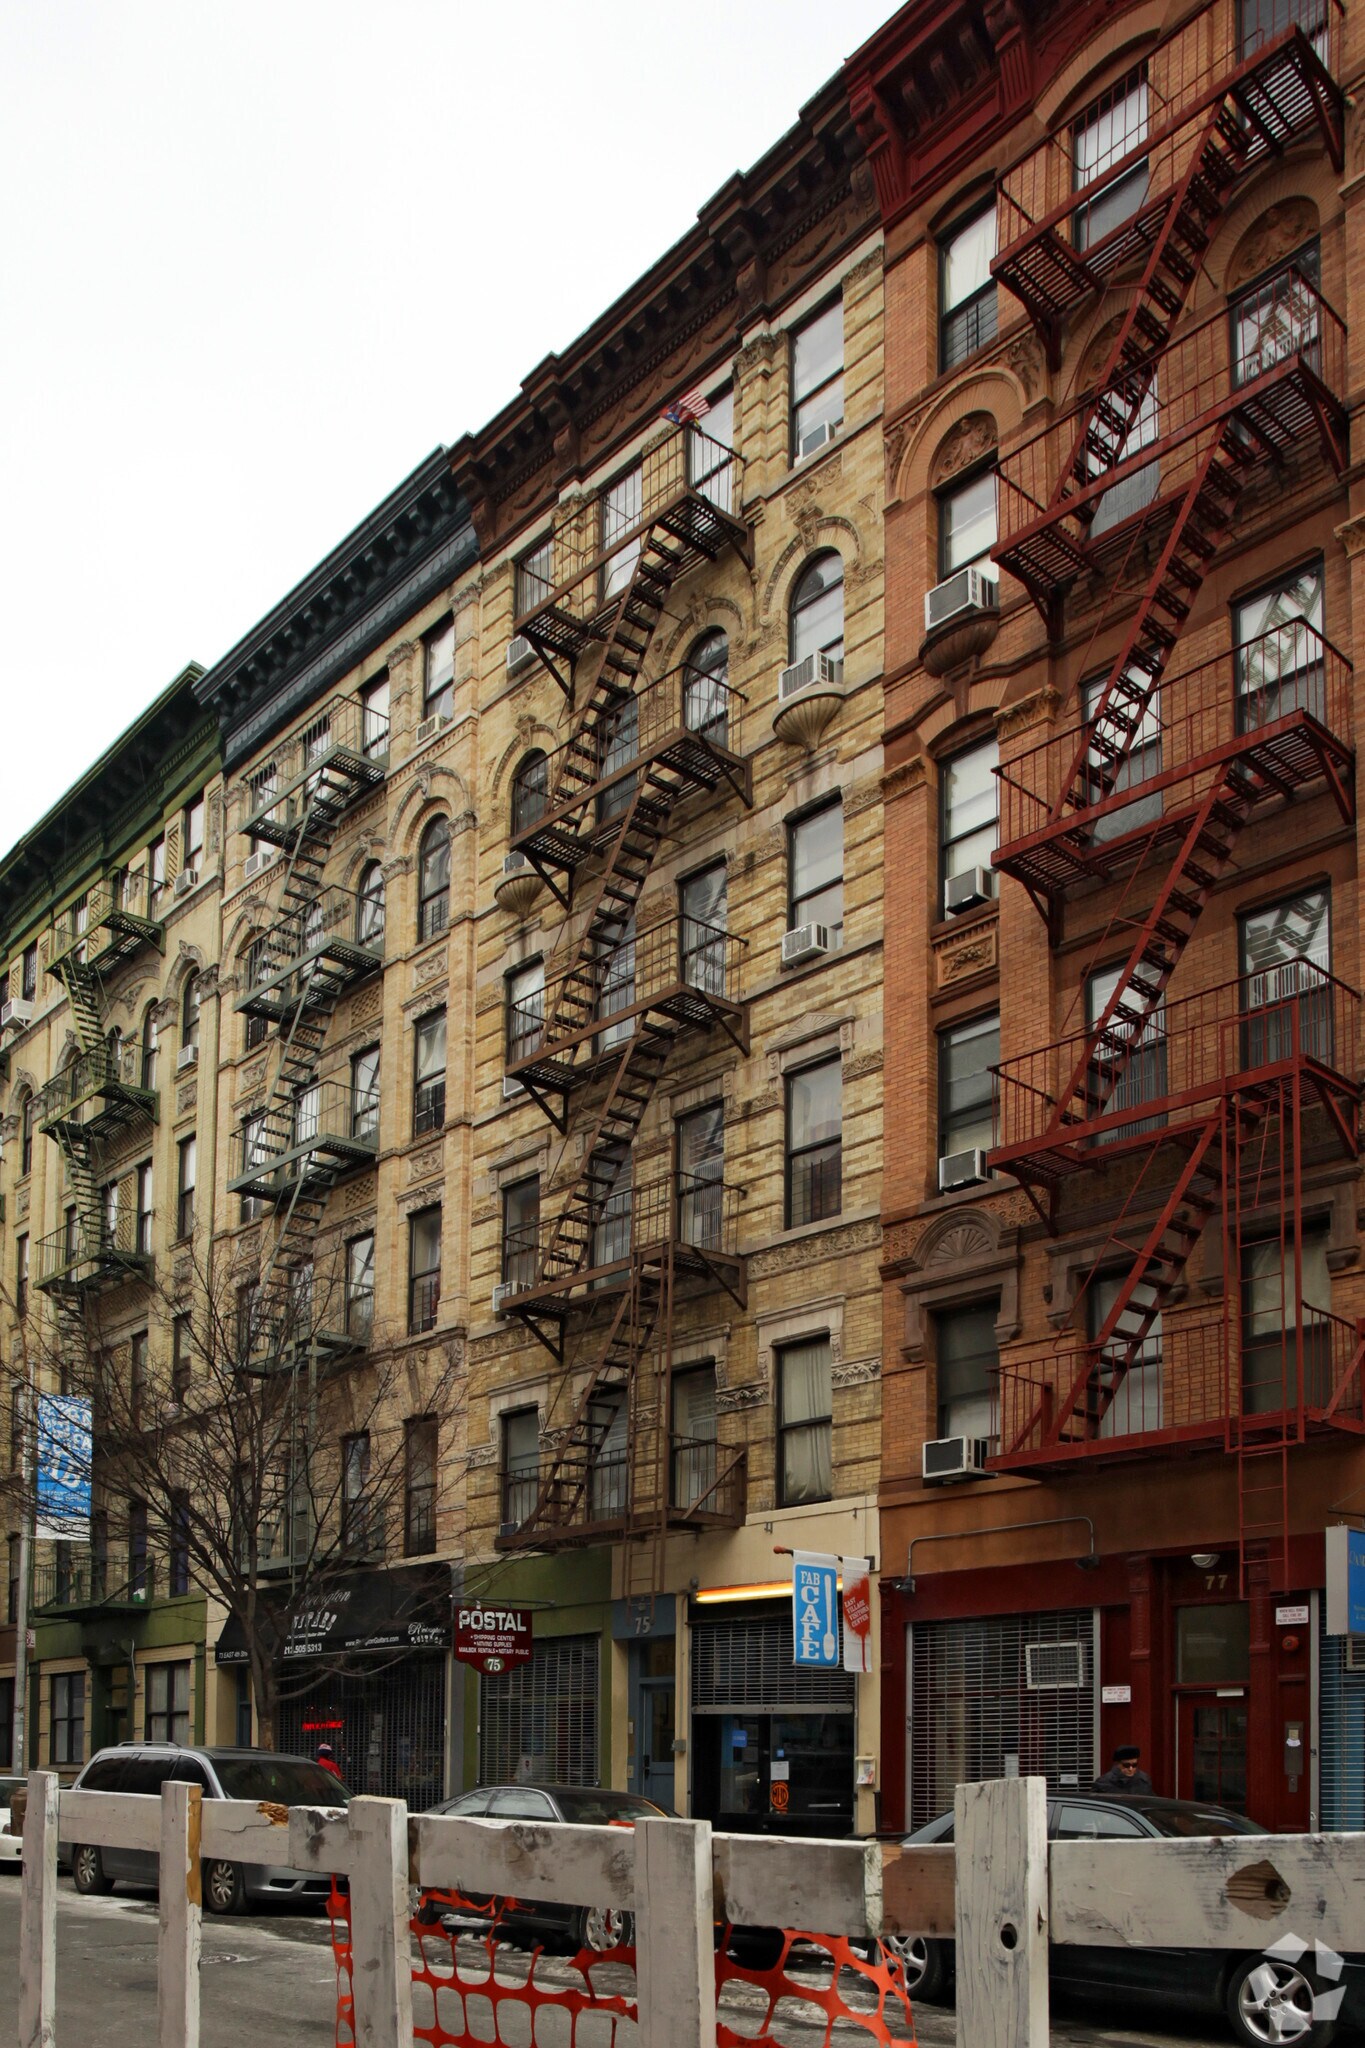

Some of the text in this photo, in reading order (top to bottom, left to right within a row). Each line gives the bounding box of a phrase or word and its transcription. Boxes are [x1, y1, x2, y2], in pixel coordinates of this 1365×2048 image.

[801, 1571, 821, 1585] FAB
[1205, 1574, 1228, 1590] 77
[845, 1597, 856, 1608] EAST
[846, 1599, 866, 1614] VILLAGE
[849, 1605, 870, 1621] VISITORS
[851, 1613, 869, 1628] CENTER
[458, 1610, 527, 1632] POSTAL
[635, 1616, 650, 1635] 75
[800, 1586, 821, 1659] CAFE
[487, 1658, 501, 1671] 75
